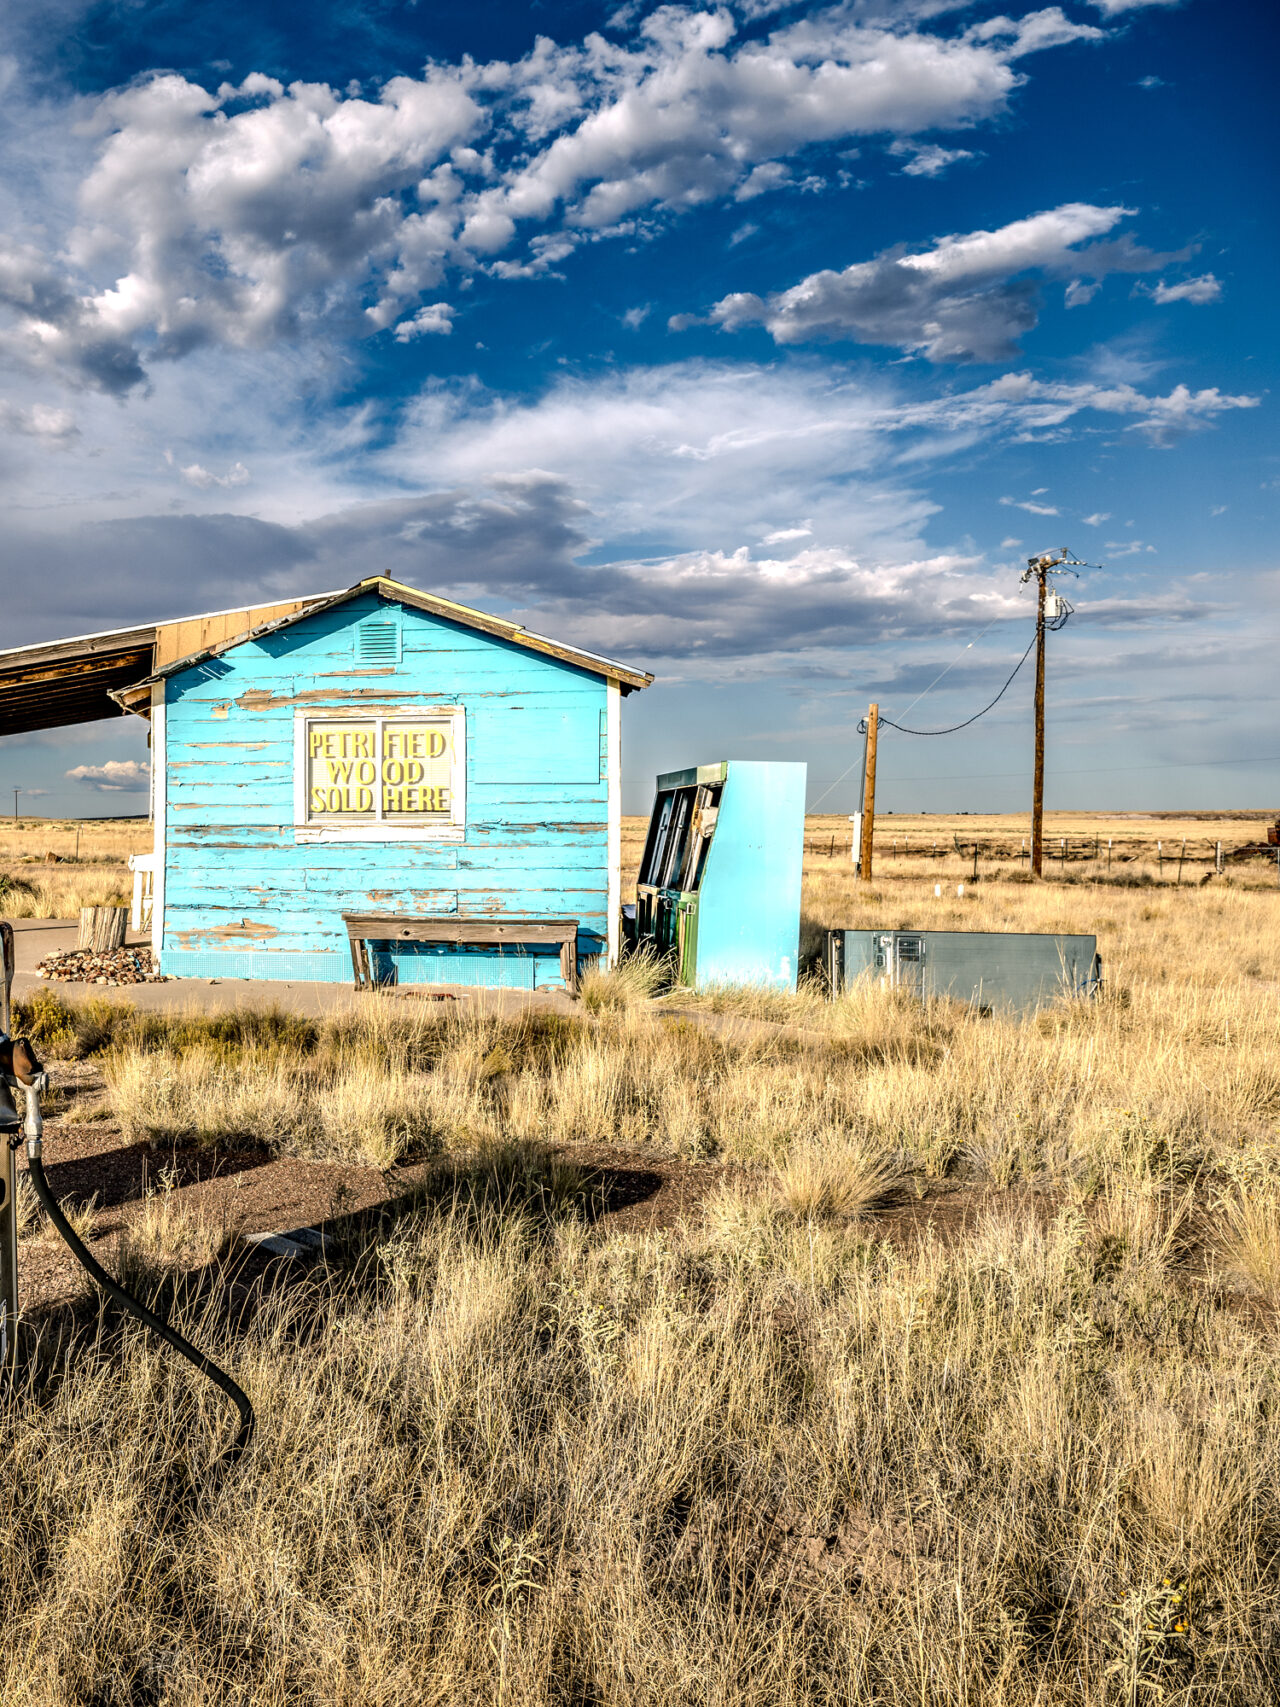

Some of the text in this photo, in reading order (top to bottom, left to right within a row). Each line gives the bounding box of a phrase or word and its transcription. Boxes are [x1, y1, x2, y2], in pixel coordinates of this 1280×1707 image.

[310, 729, 445, 758] PETRIFIED
[327, 758, 424, 785] WOOD
[311, 785, 449, 812] SOLD HERE
